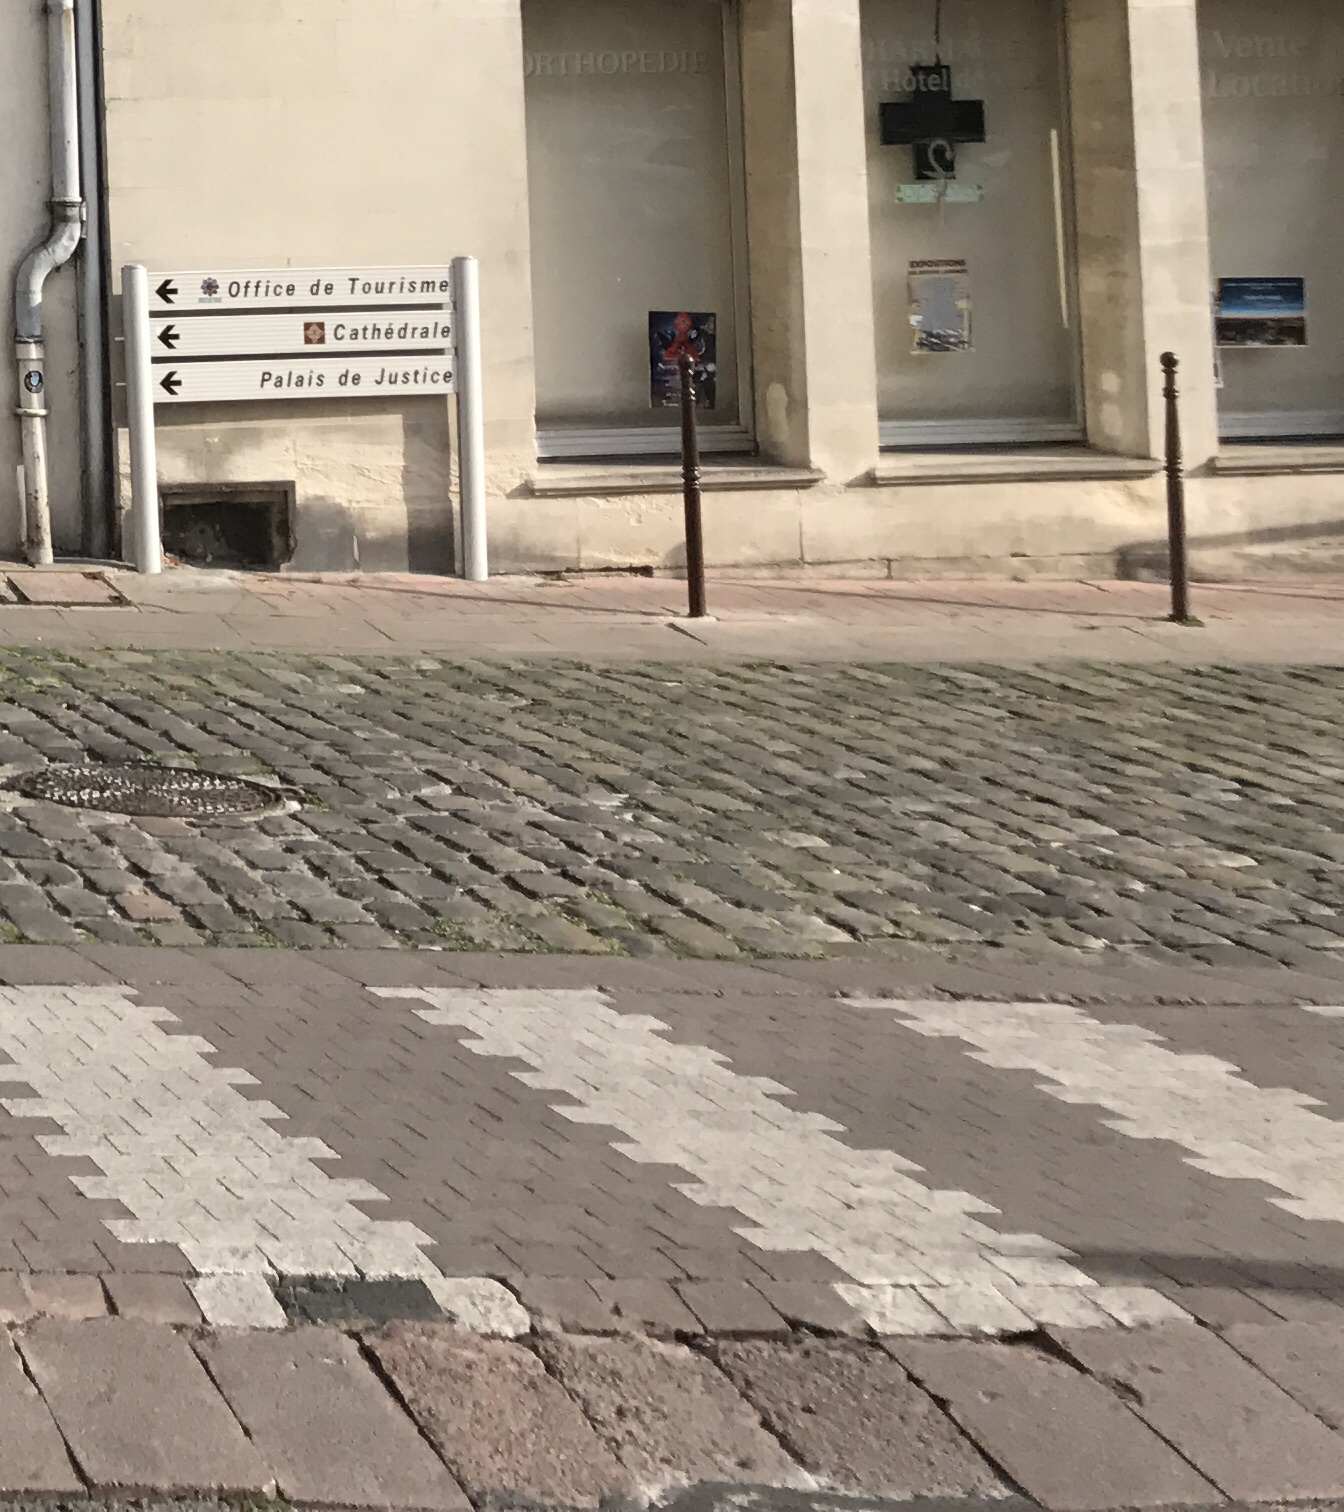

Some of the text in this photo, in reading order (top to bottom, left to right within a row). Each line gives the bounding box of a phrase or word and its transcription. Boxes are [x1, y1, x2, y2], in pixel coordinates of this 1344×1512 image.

[227, 277, 449, 299] Office de Tourisme
[333, 322, 451, 341] Cathédrale
[259, 367, 454, 389] Palais de Justice
